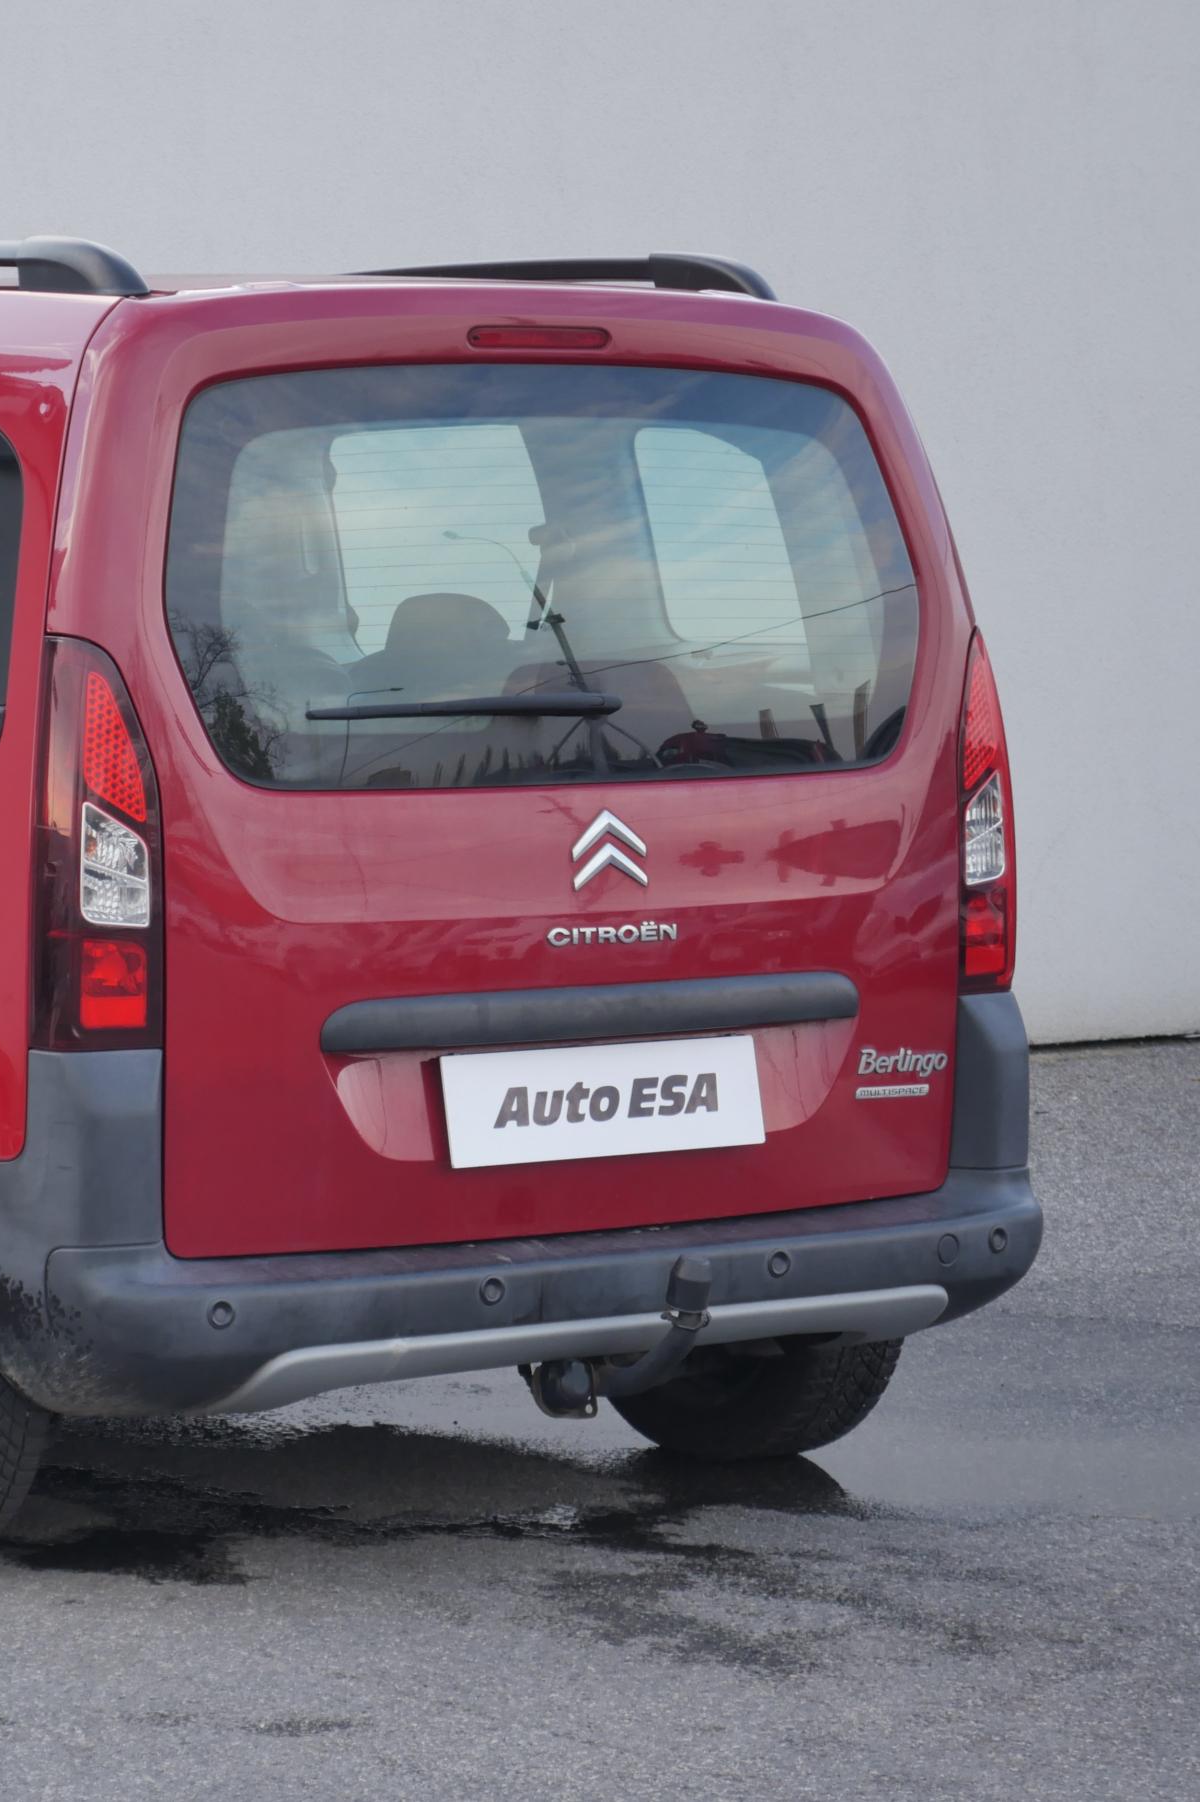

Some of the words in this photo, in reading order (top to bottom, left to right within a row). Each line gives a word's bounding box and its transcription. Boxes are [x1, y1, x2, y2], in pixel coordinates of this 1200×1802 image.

[547, 920, 677, 947] CITROËN
[858, 1047, 948, 1077] Berlingo
[494, 1081, 620, 1128] Auto
[627, 1072, 719, 1118] ESA
[858, 1085, 927, 1098] MULTISPACE
